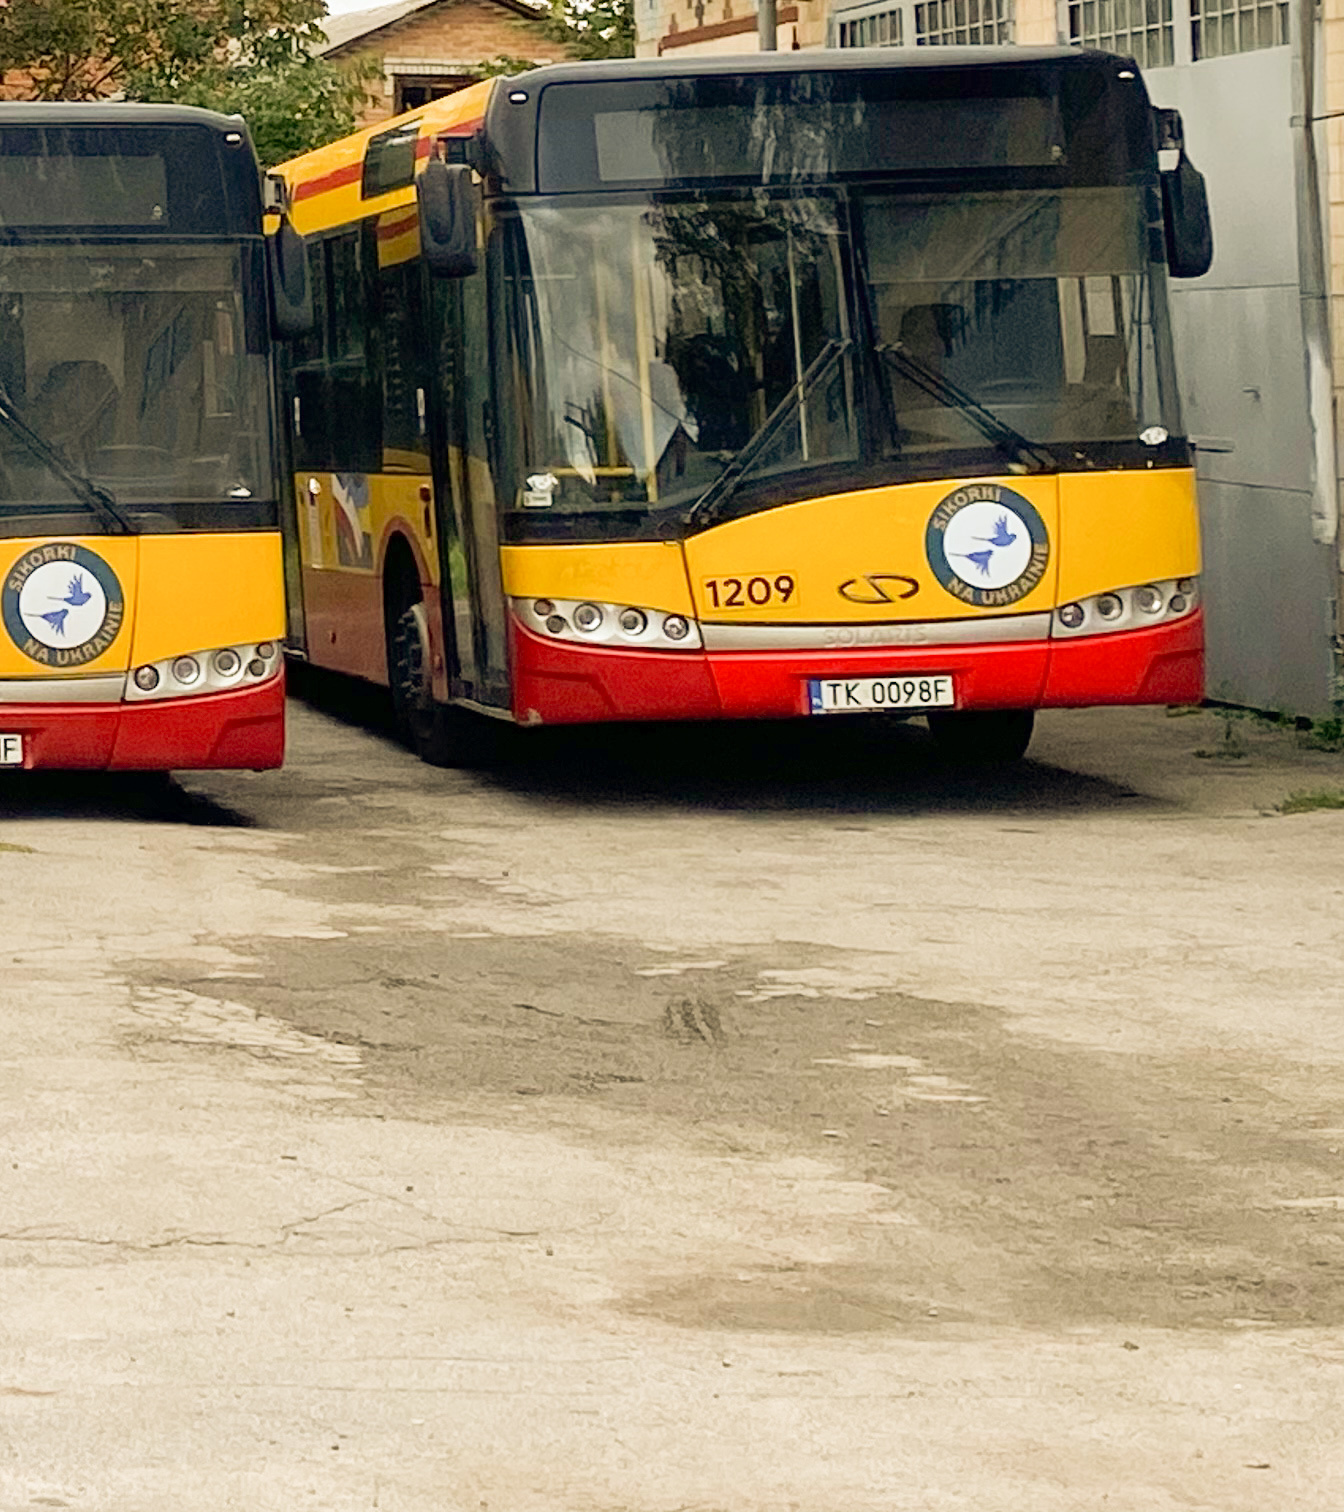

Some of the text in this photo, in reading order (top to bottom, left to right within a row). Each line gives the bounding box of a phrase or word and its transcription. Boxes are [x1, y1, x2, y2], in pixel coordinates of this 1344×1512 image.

[8, 545, 77, 593] SIKORKI
[705, 575, 795, 608] 1209
[23, 600, 123, 665] NA UKRAINIE
[826, 681, 862, 706] TK
[871, 678, 948, 705] 0098F
